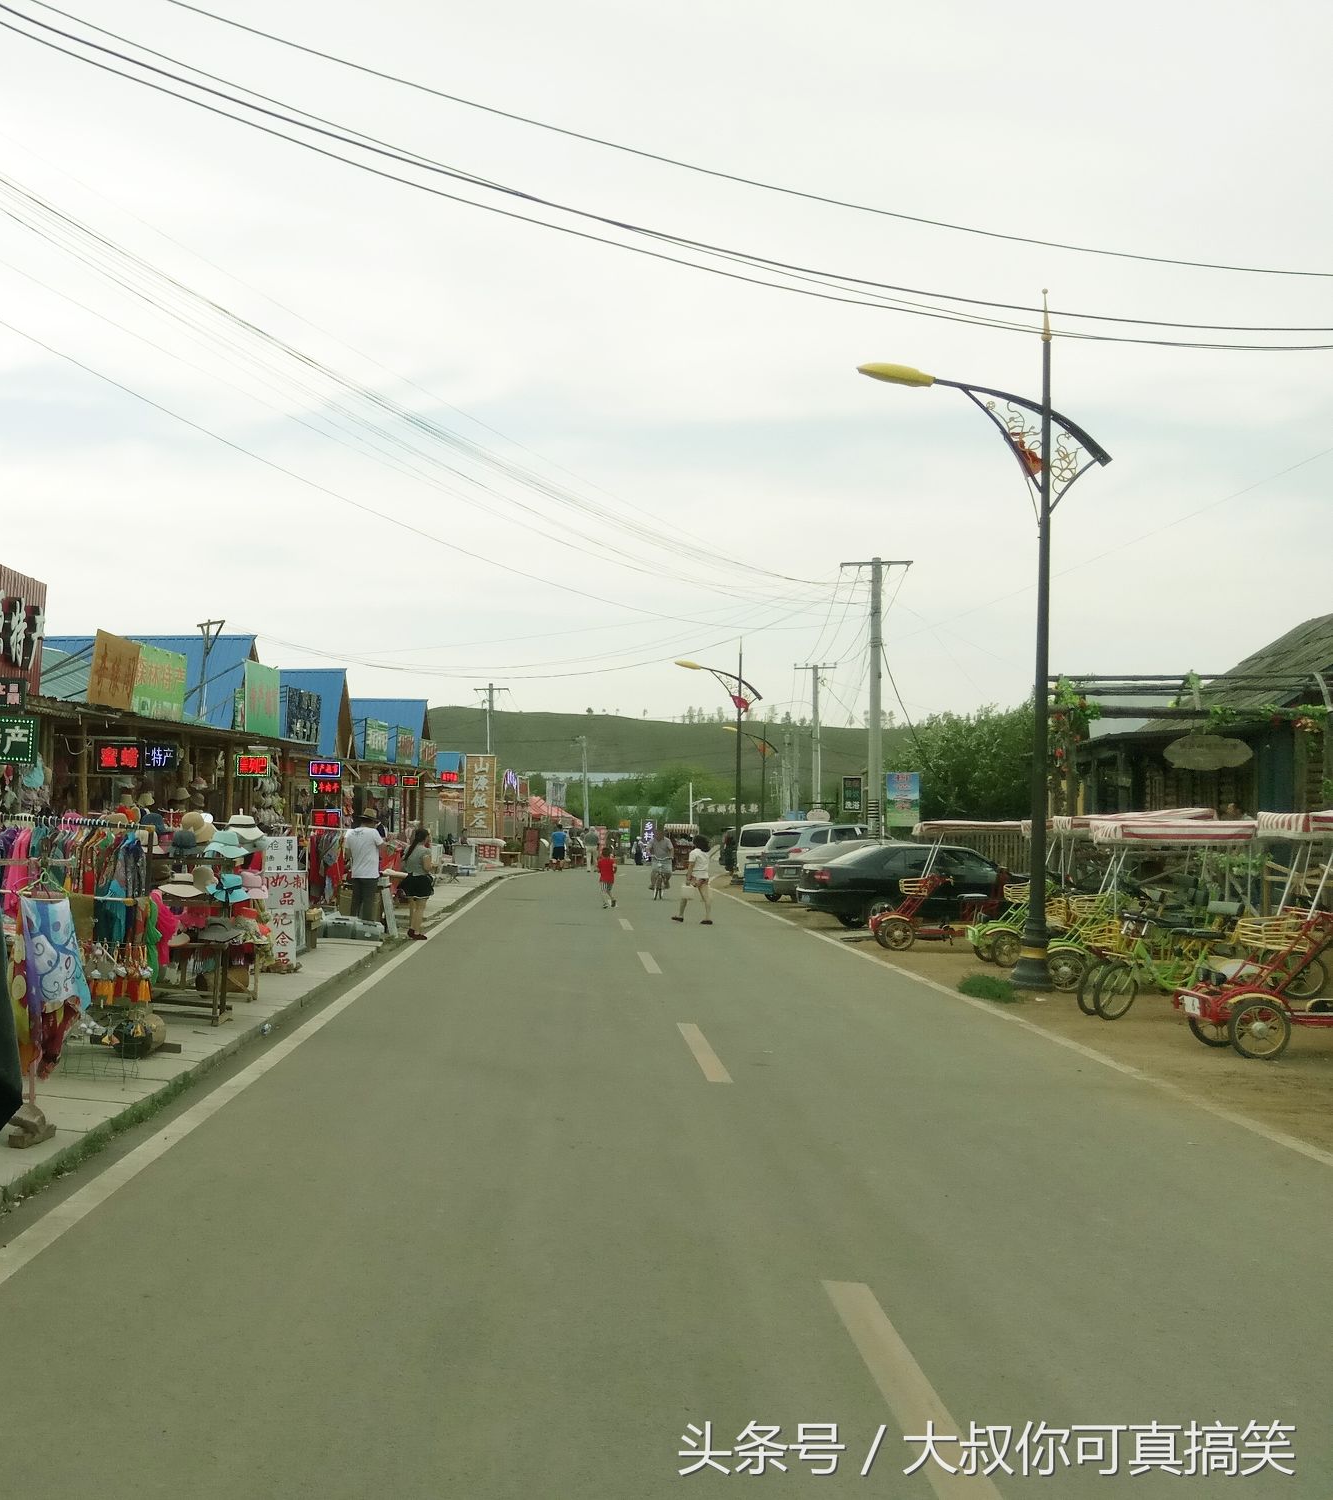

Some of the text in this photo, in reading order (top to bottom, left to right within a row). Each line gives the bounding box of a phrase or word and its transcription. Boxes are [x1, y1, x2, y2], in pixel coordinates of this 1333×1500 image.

[279, 892, 296, 906] 品
[272, 912, 295, 966] 纪念品
